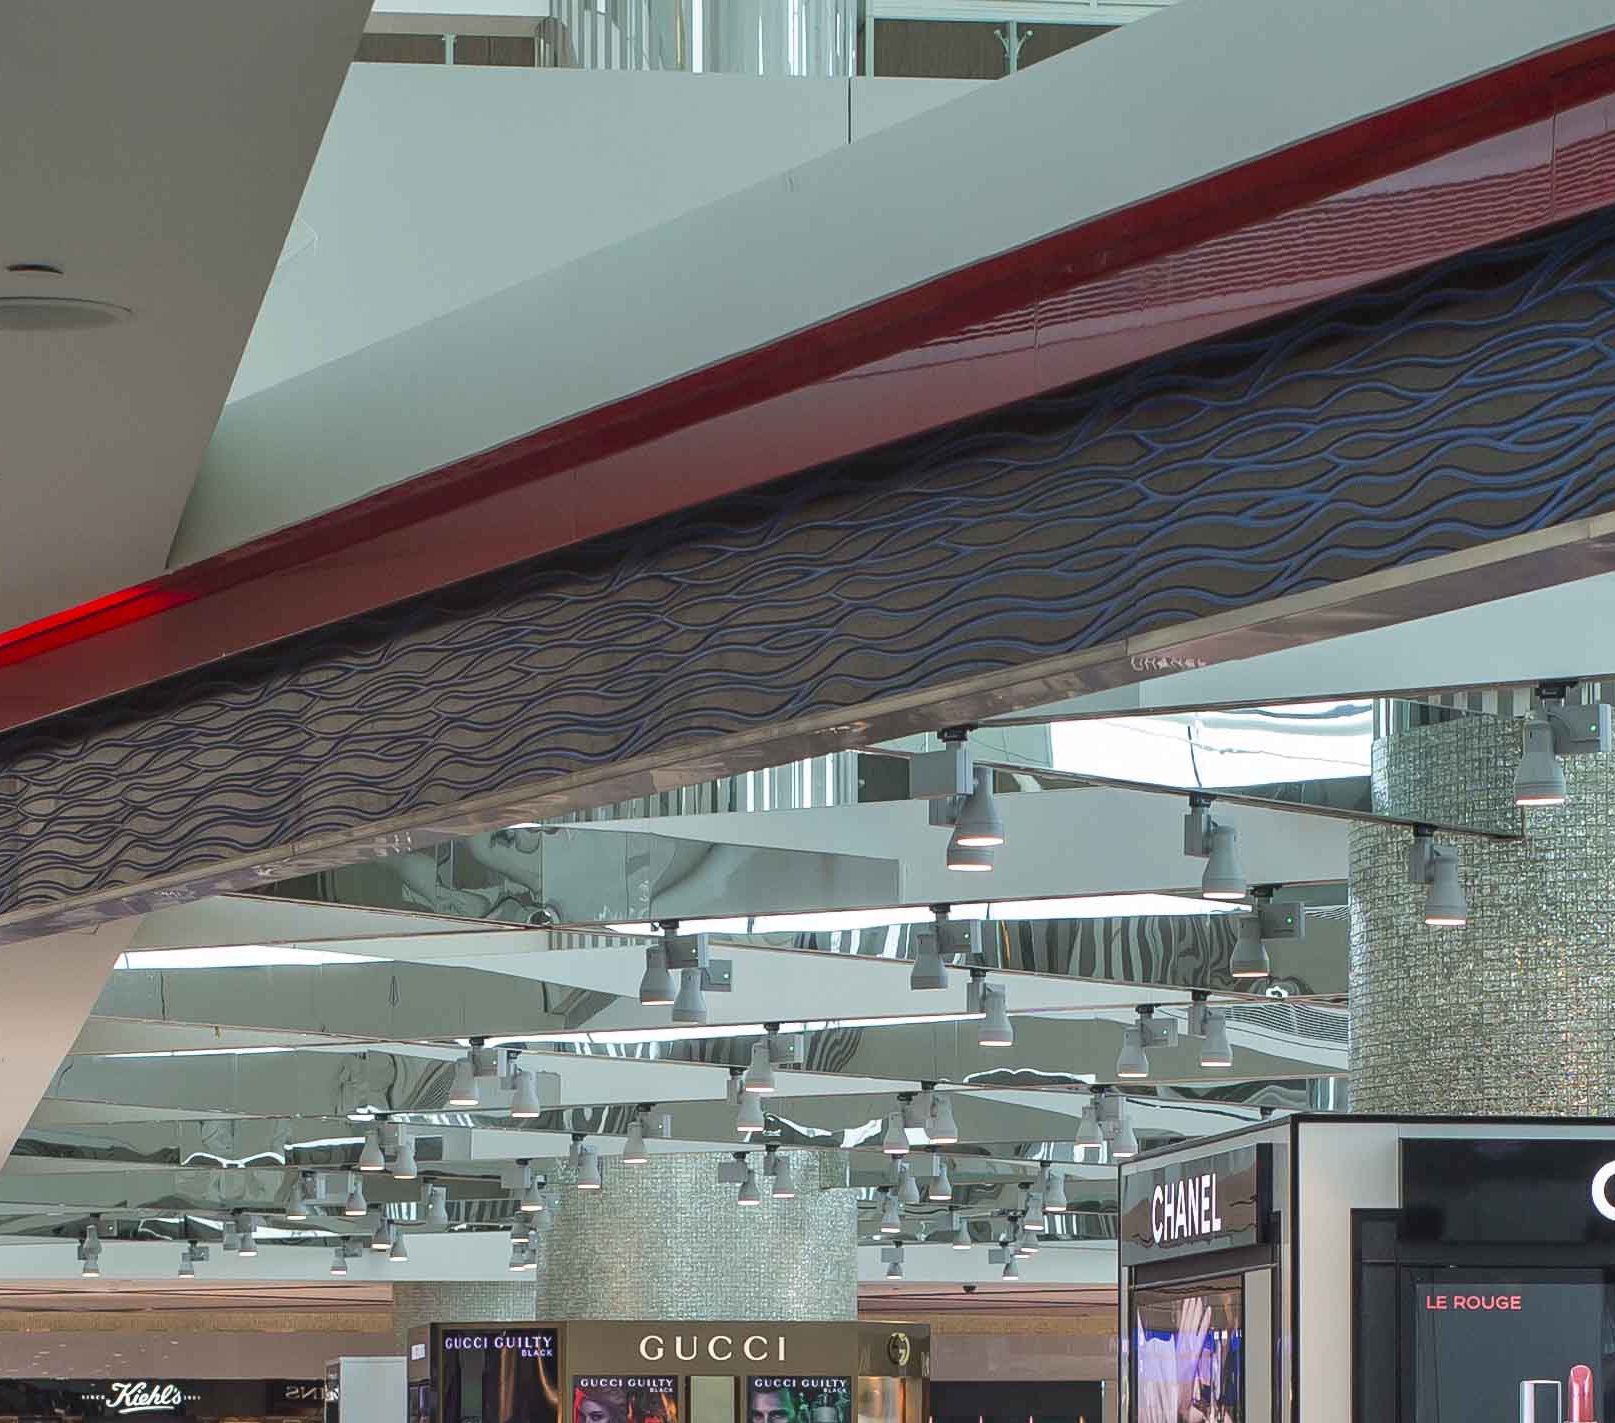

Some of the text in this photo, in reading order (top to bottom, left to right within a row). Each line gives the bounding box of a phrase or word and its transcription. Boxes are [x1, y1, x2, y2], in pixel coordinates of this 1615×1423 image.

[1151, 1172, 1222, 1243] CHANEL
[1426, 1295, 1522, 1310] LE ROUGE
[444, 1336, 553, 1349] GUCCI GUILTY
[639, 1335, 786, 1361] GUCCI
[521, 1349, 553, 1357] BLACK
[580, 1378, 674, 1388] GUCCI GUILTY
[754, 1378, 847, 1388] GUCCI GUILTY
[105, 1382, 182, 1408] Kiehl's
